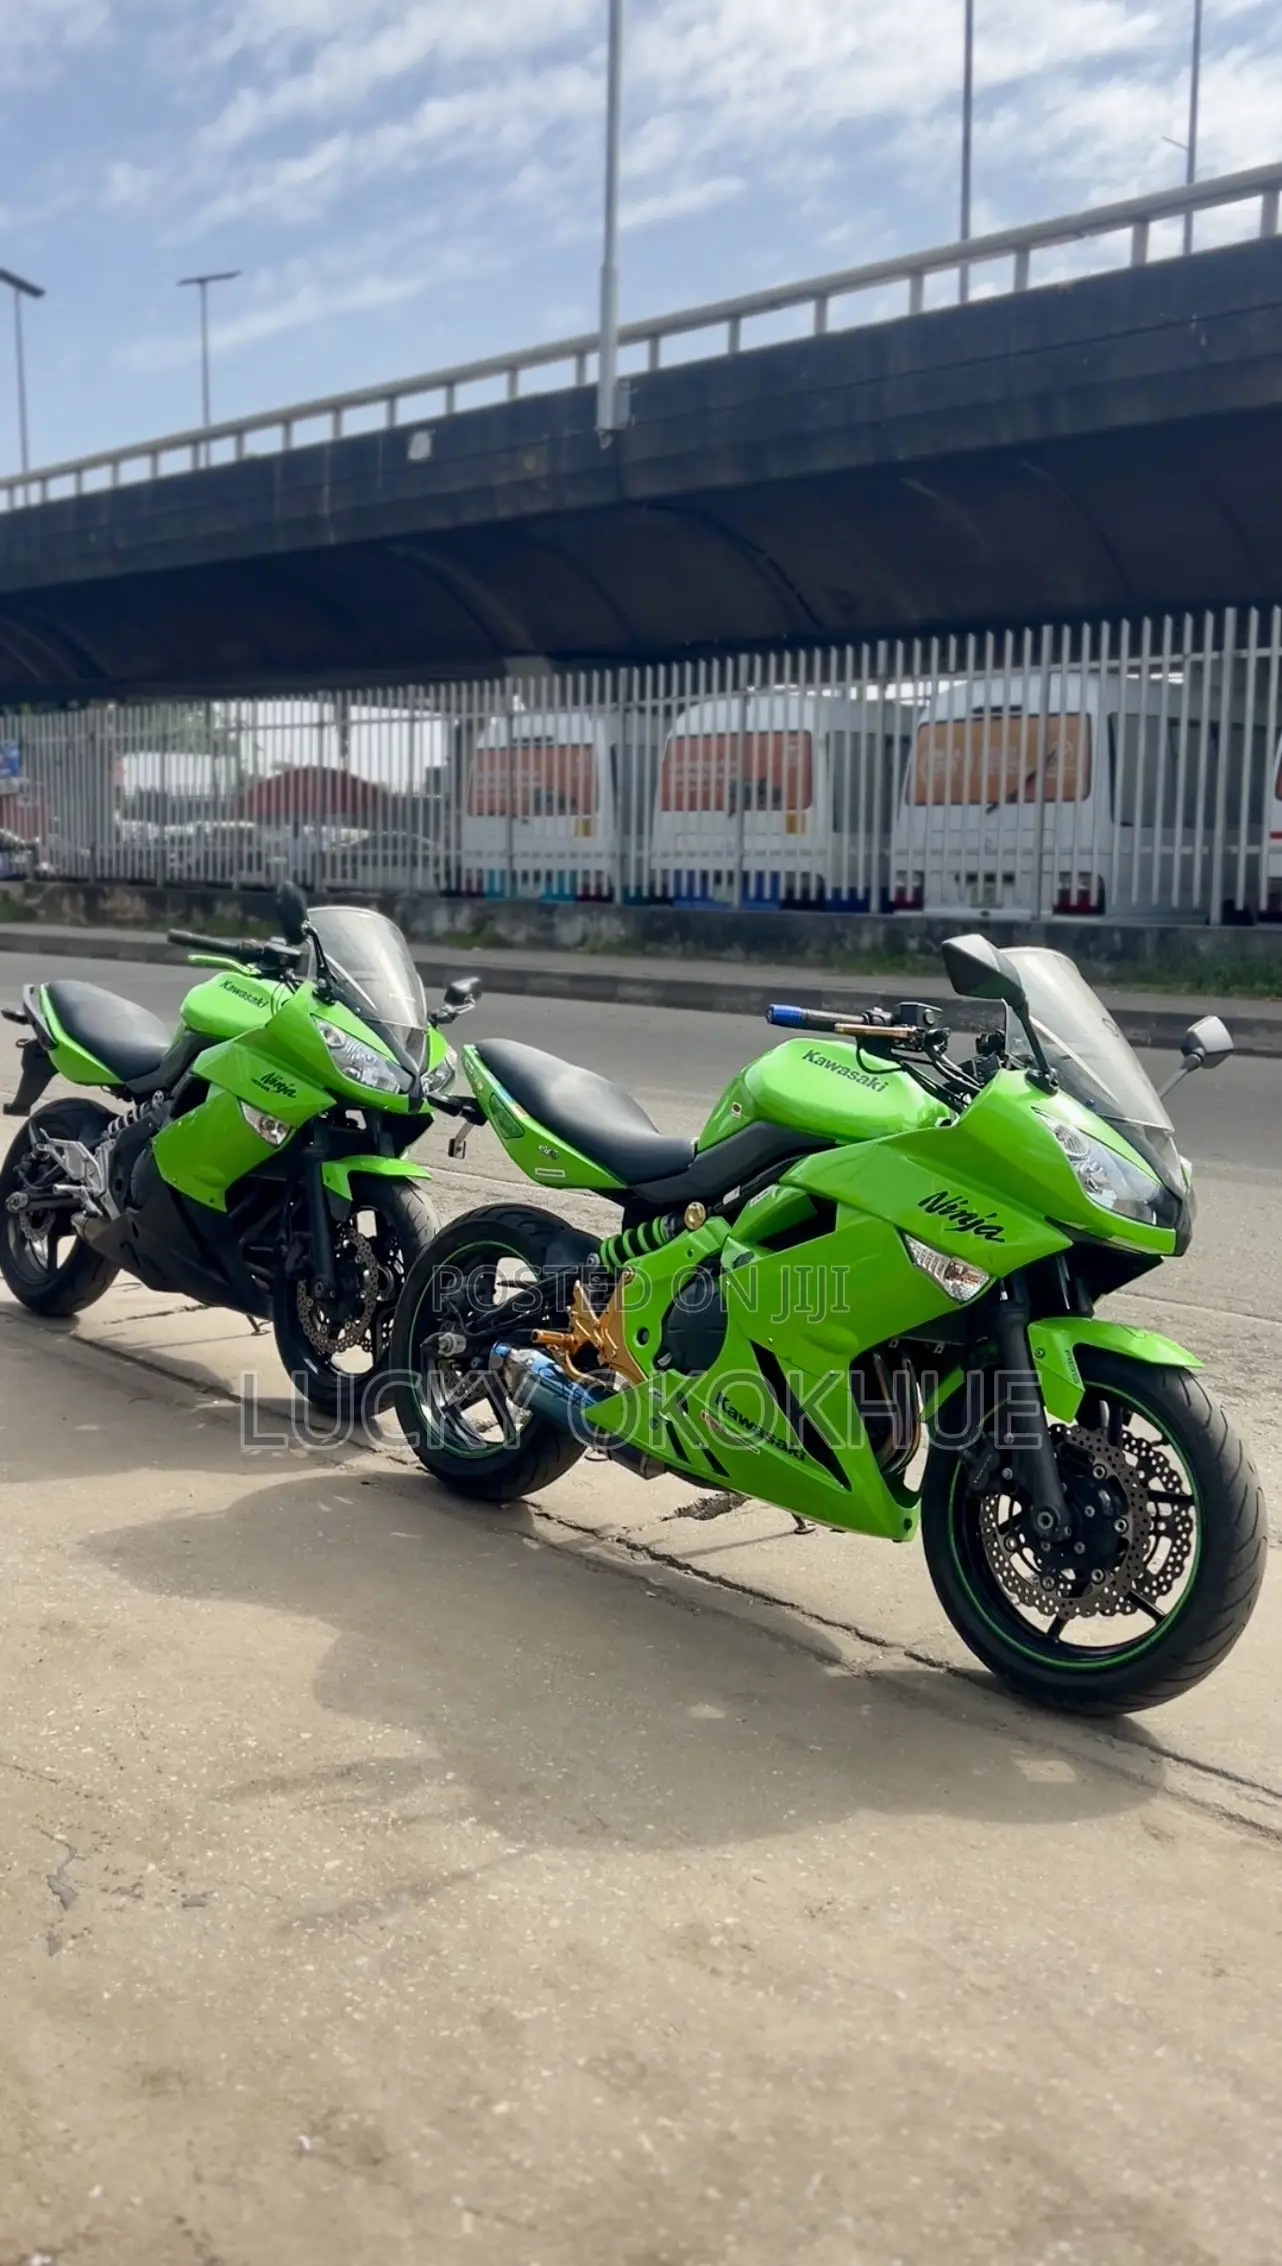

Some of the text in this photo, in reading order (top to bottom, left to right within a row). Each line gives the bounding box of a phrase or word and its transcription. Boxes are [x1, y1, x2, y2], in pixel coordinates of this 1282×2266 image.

[220, 980, 269, 1008] Kawasaki
[260, 1072, 296, 1099] Ninja
[802, 1049, 889, 1092] Kawasaki
[918, 1190, 1005, 1243] Ninja
[714, 1391, 806, 1461] Kawasaki
